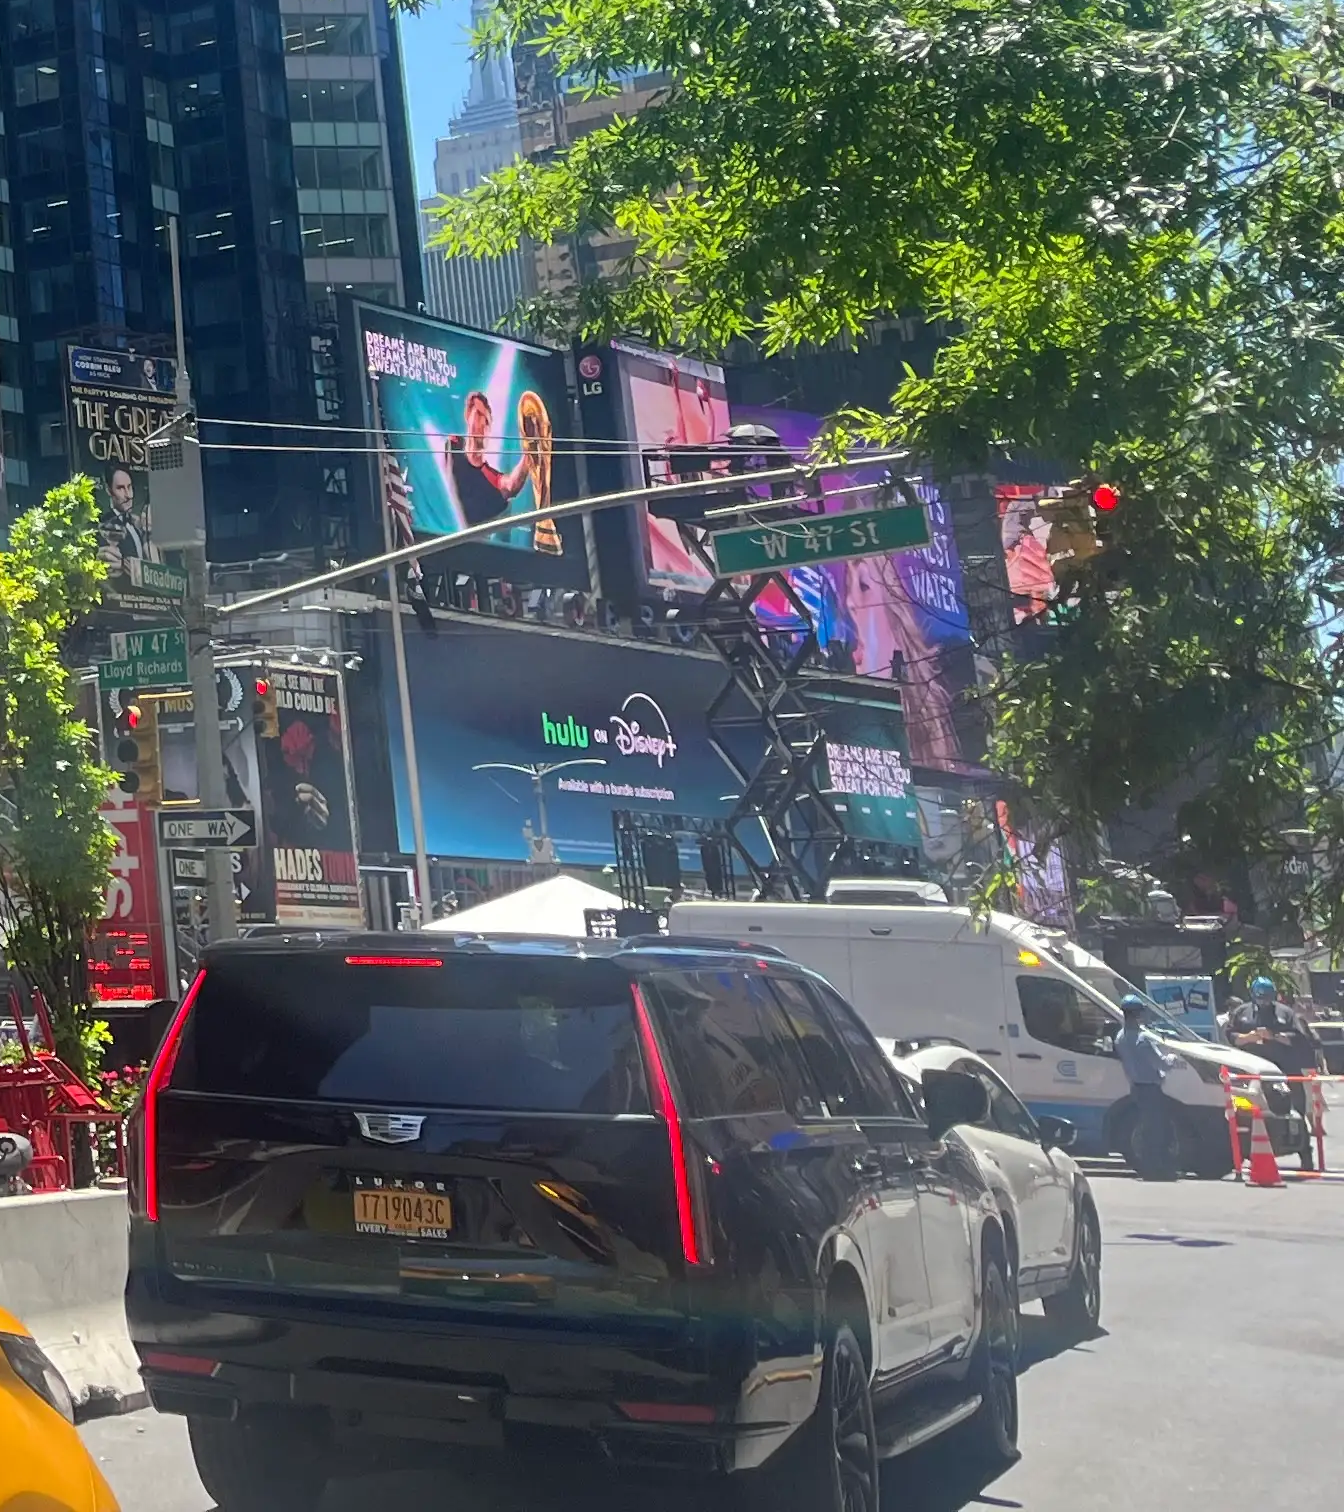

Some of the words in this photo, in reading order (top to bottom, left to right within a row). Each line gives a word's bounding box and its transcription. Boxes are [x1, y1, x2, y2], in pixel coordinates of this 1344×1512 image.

[365, 330, 405, 353] DREAMS
[407, 341, 425, 359] ARE
[426, 346, 447, 364] JUST
[367, 344, 406, 366] DREAMS
[408, 353, 434, 373] UNTIL
[437, 362, 457, 378] YOU
[369, 356, 401, 377] SWEAT
[403, 365, 422, 382] FOR
[423, 371, 450, 389] THEM
[583, 381, 603, 396] LG
[73, 397, 111, 431] THE
[114, 405, 176, 435] GREA
[89, 431, 150, 465] GATS
[762, 533, 788, 560] W
[803, 525, 834, 554] 47
[848, 518, 880, 548] St
[143, 564, 187, 592] Broadway
[909, 567, 960, 614] WATER
[129, 635, 144, 656] W
[151, 633, 168, 654] 47
[174, 630, 185, 645] St
[103, 663, 133, 680] Lloyd
[136, 659, 183, 677] Richards
[294, 692, 324, 714] COULD
[324, 695, 338, 715] BE
[541, 711, 590, 749] hulu
[593, 728, 608, 744] ON
[826, 741, 864, 764] DREAMS
[864, 747, 883, 765] ARE
[828, 758, 866, 779] DREAMS
[558, 777, 589, 793] Available
[589, 780, 605, 795] with
[610, 783, 635, 797] bundle
[634, 786, 675, 802] subscription
[862, 777, 881, 797] FOR
[168, 821, 195, 837] ONE
[208, 820, 237, 837] WAY
[179, 860, 197, 876] ONE
[355, 1176, 445, 1192] LUXOR
[360, 1193, 445, 1225] T719043C
[355, 1222, 387, 1234] LIVERY
[420, 1228, 448, 1239] SALES
